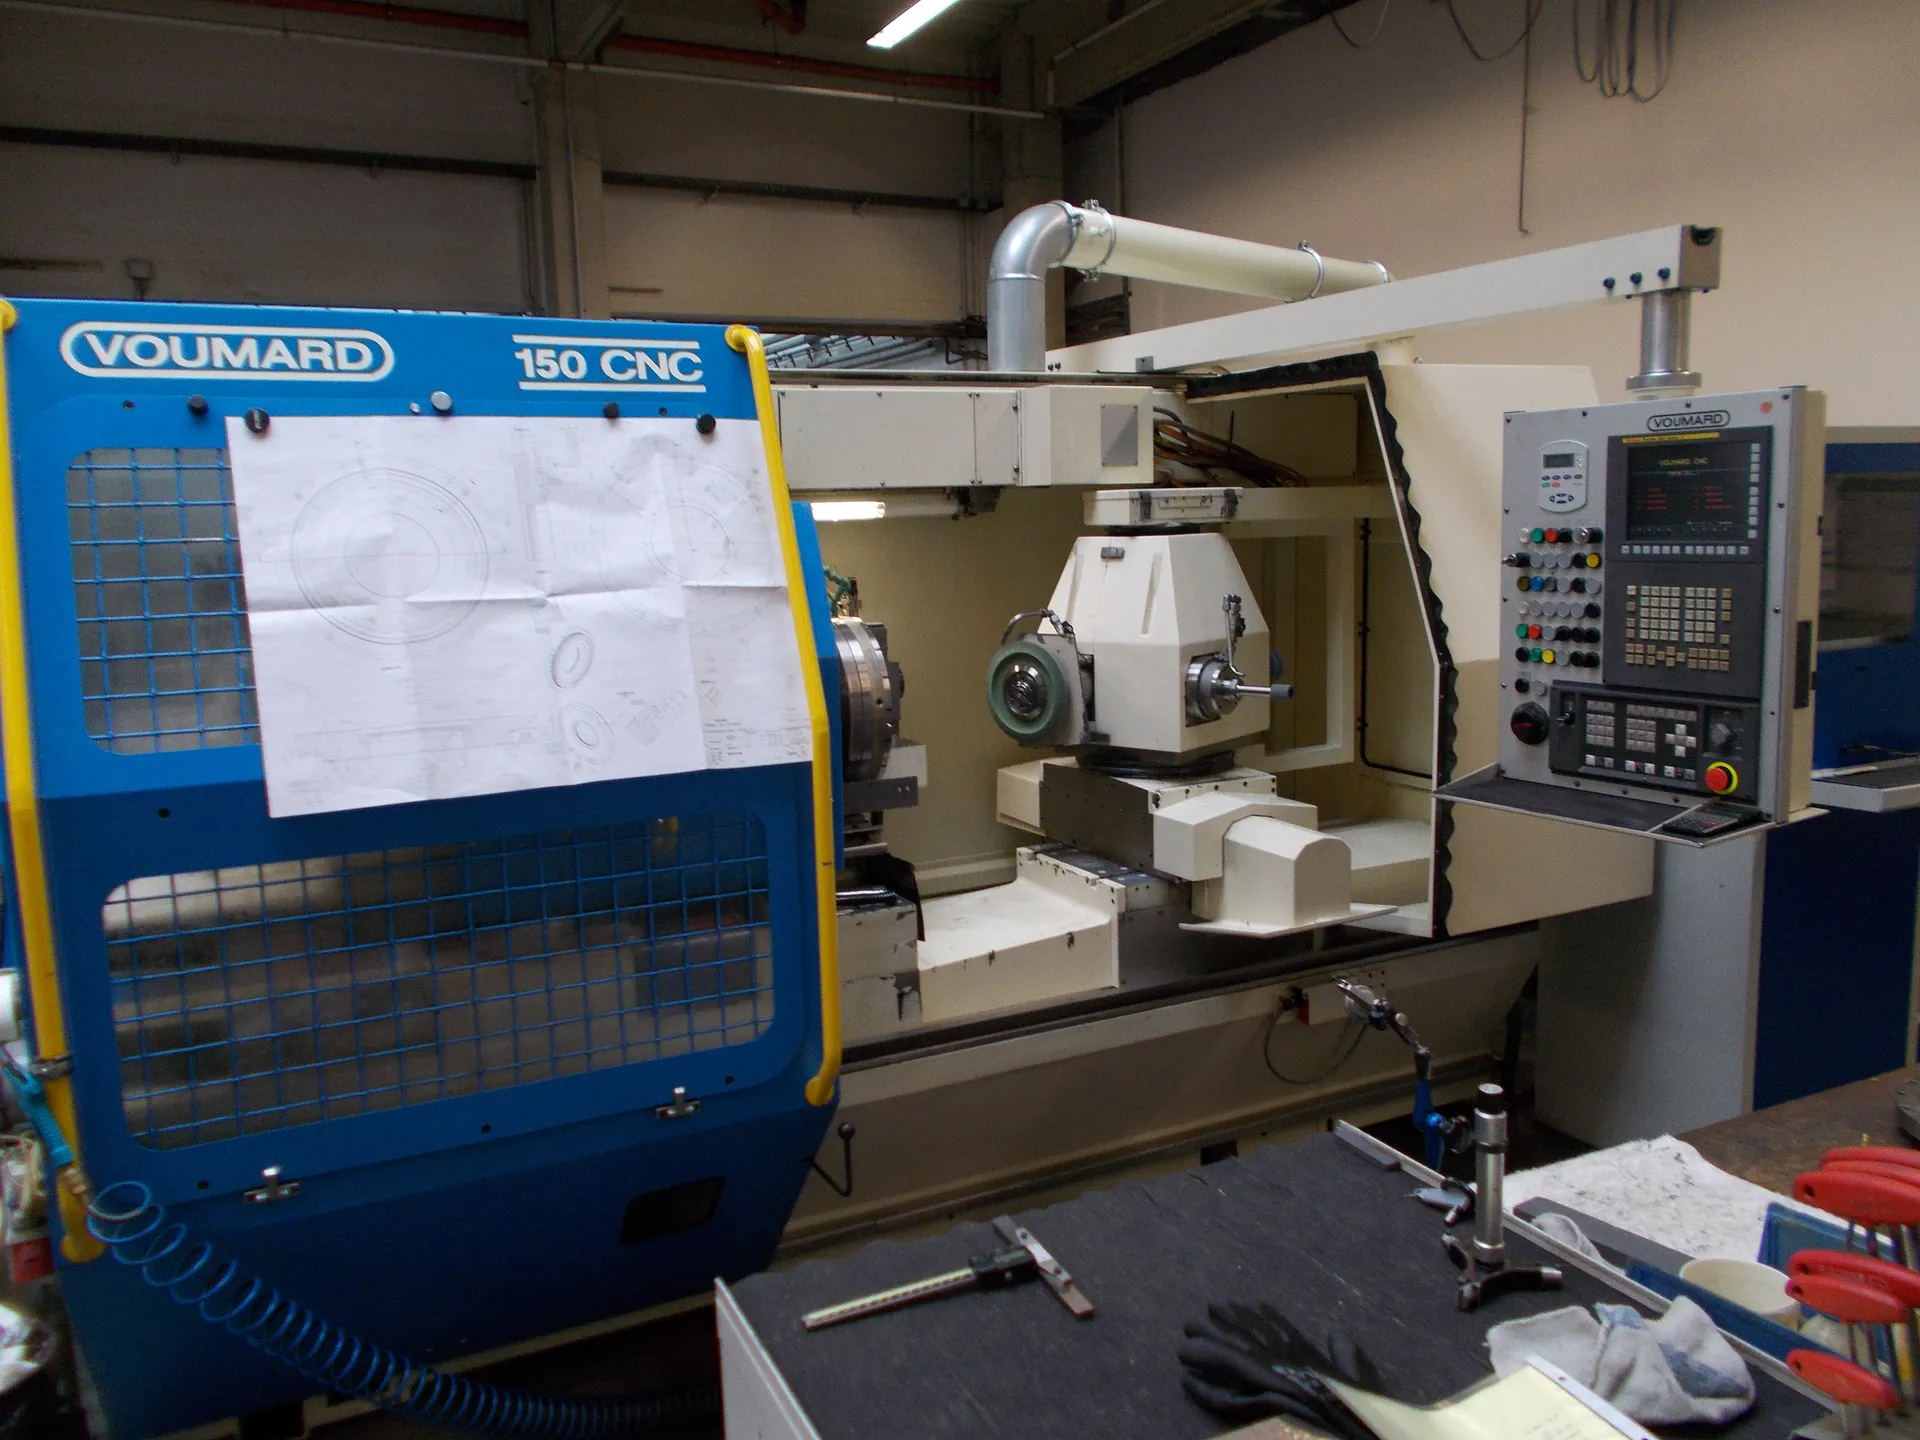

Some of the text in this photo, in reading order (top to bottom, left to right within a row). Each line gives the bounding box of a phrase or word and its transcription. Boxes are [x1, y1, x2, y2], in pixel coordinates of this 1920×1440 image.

[83, 333, 373, 371] VOUMARD
[514, 347, 704, 382] 150 CNC
[1653, 413, 1724, 428] VOUMARD
